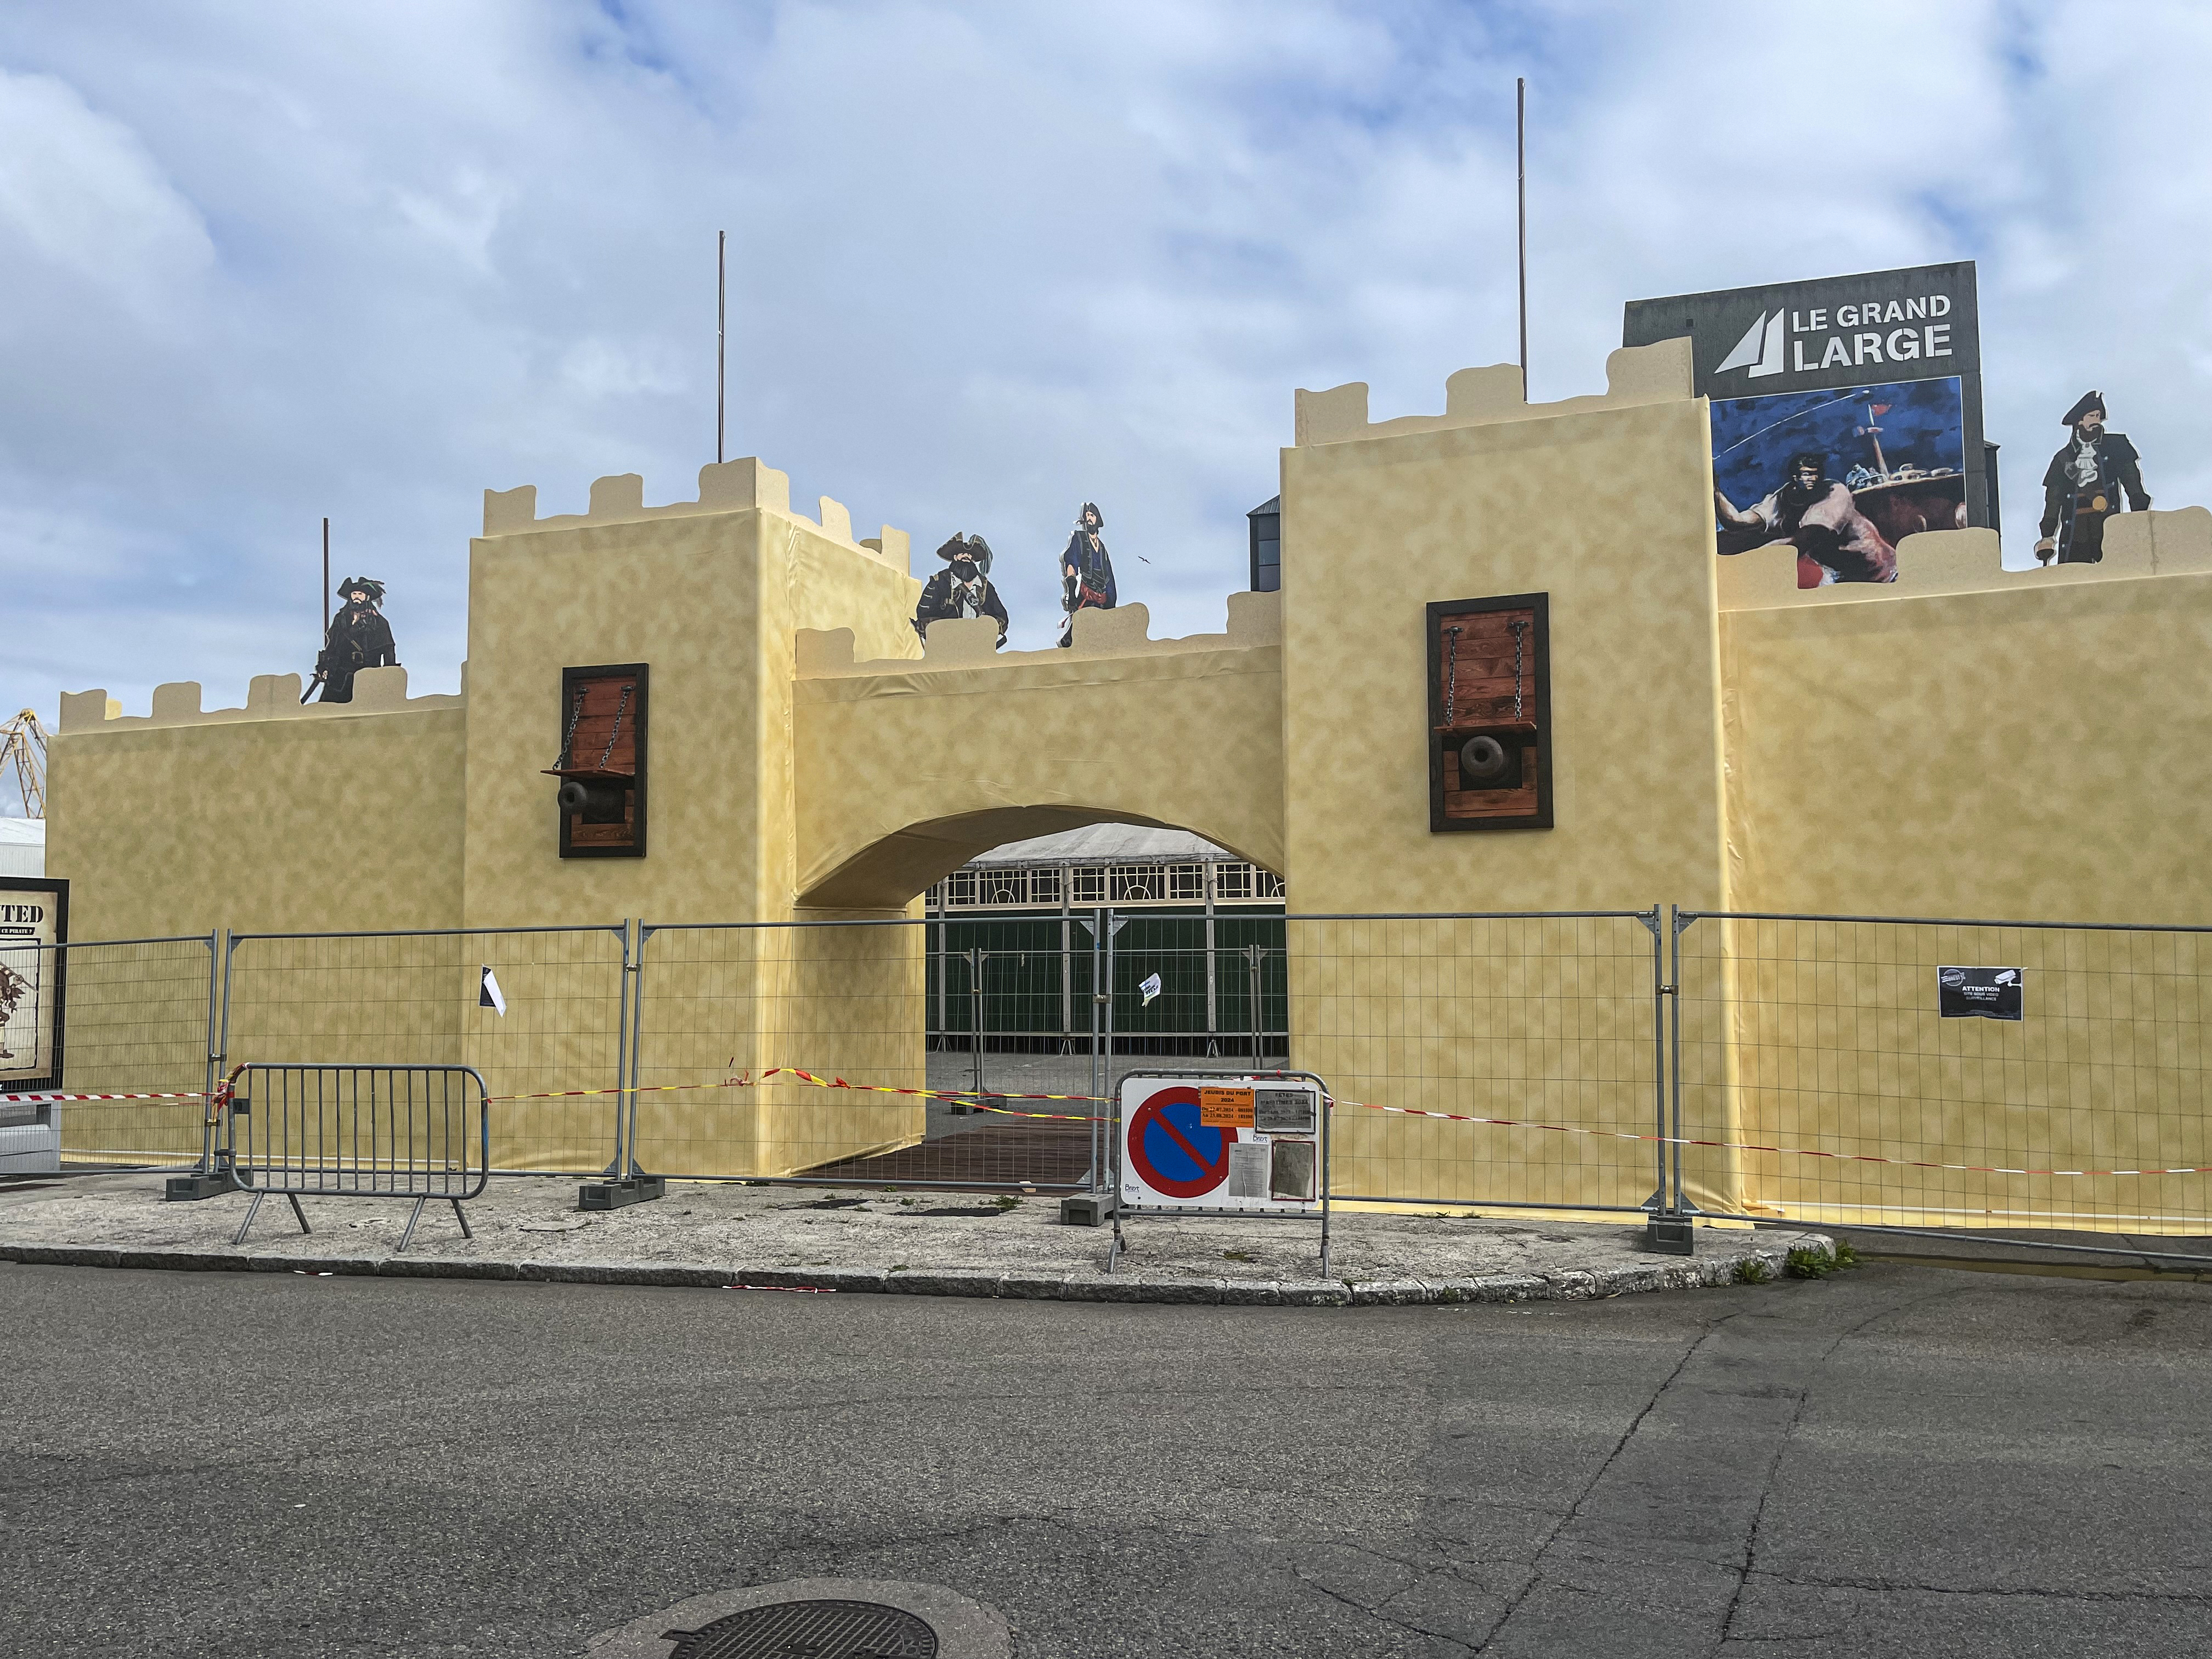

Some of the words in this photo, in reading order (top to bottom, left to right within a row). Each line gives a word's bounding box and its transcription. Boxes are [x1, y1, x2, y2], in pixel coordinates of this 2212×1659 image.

[1792, 308, 1828, 332] LE
[1837, 295, 1951, 328] GRAND
[1793, 324, 1953, 372] LARGE
[0, 905, 43, 923] TED
[1125, 1183, 1139, 1192] Brest
